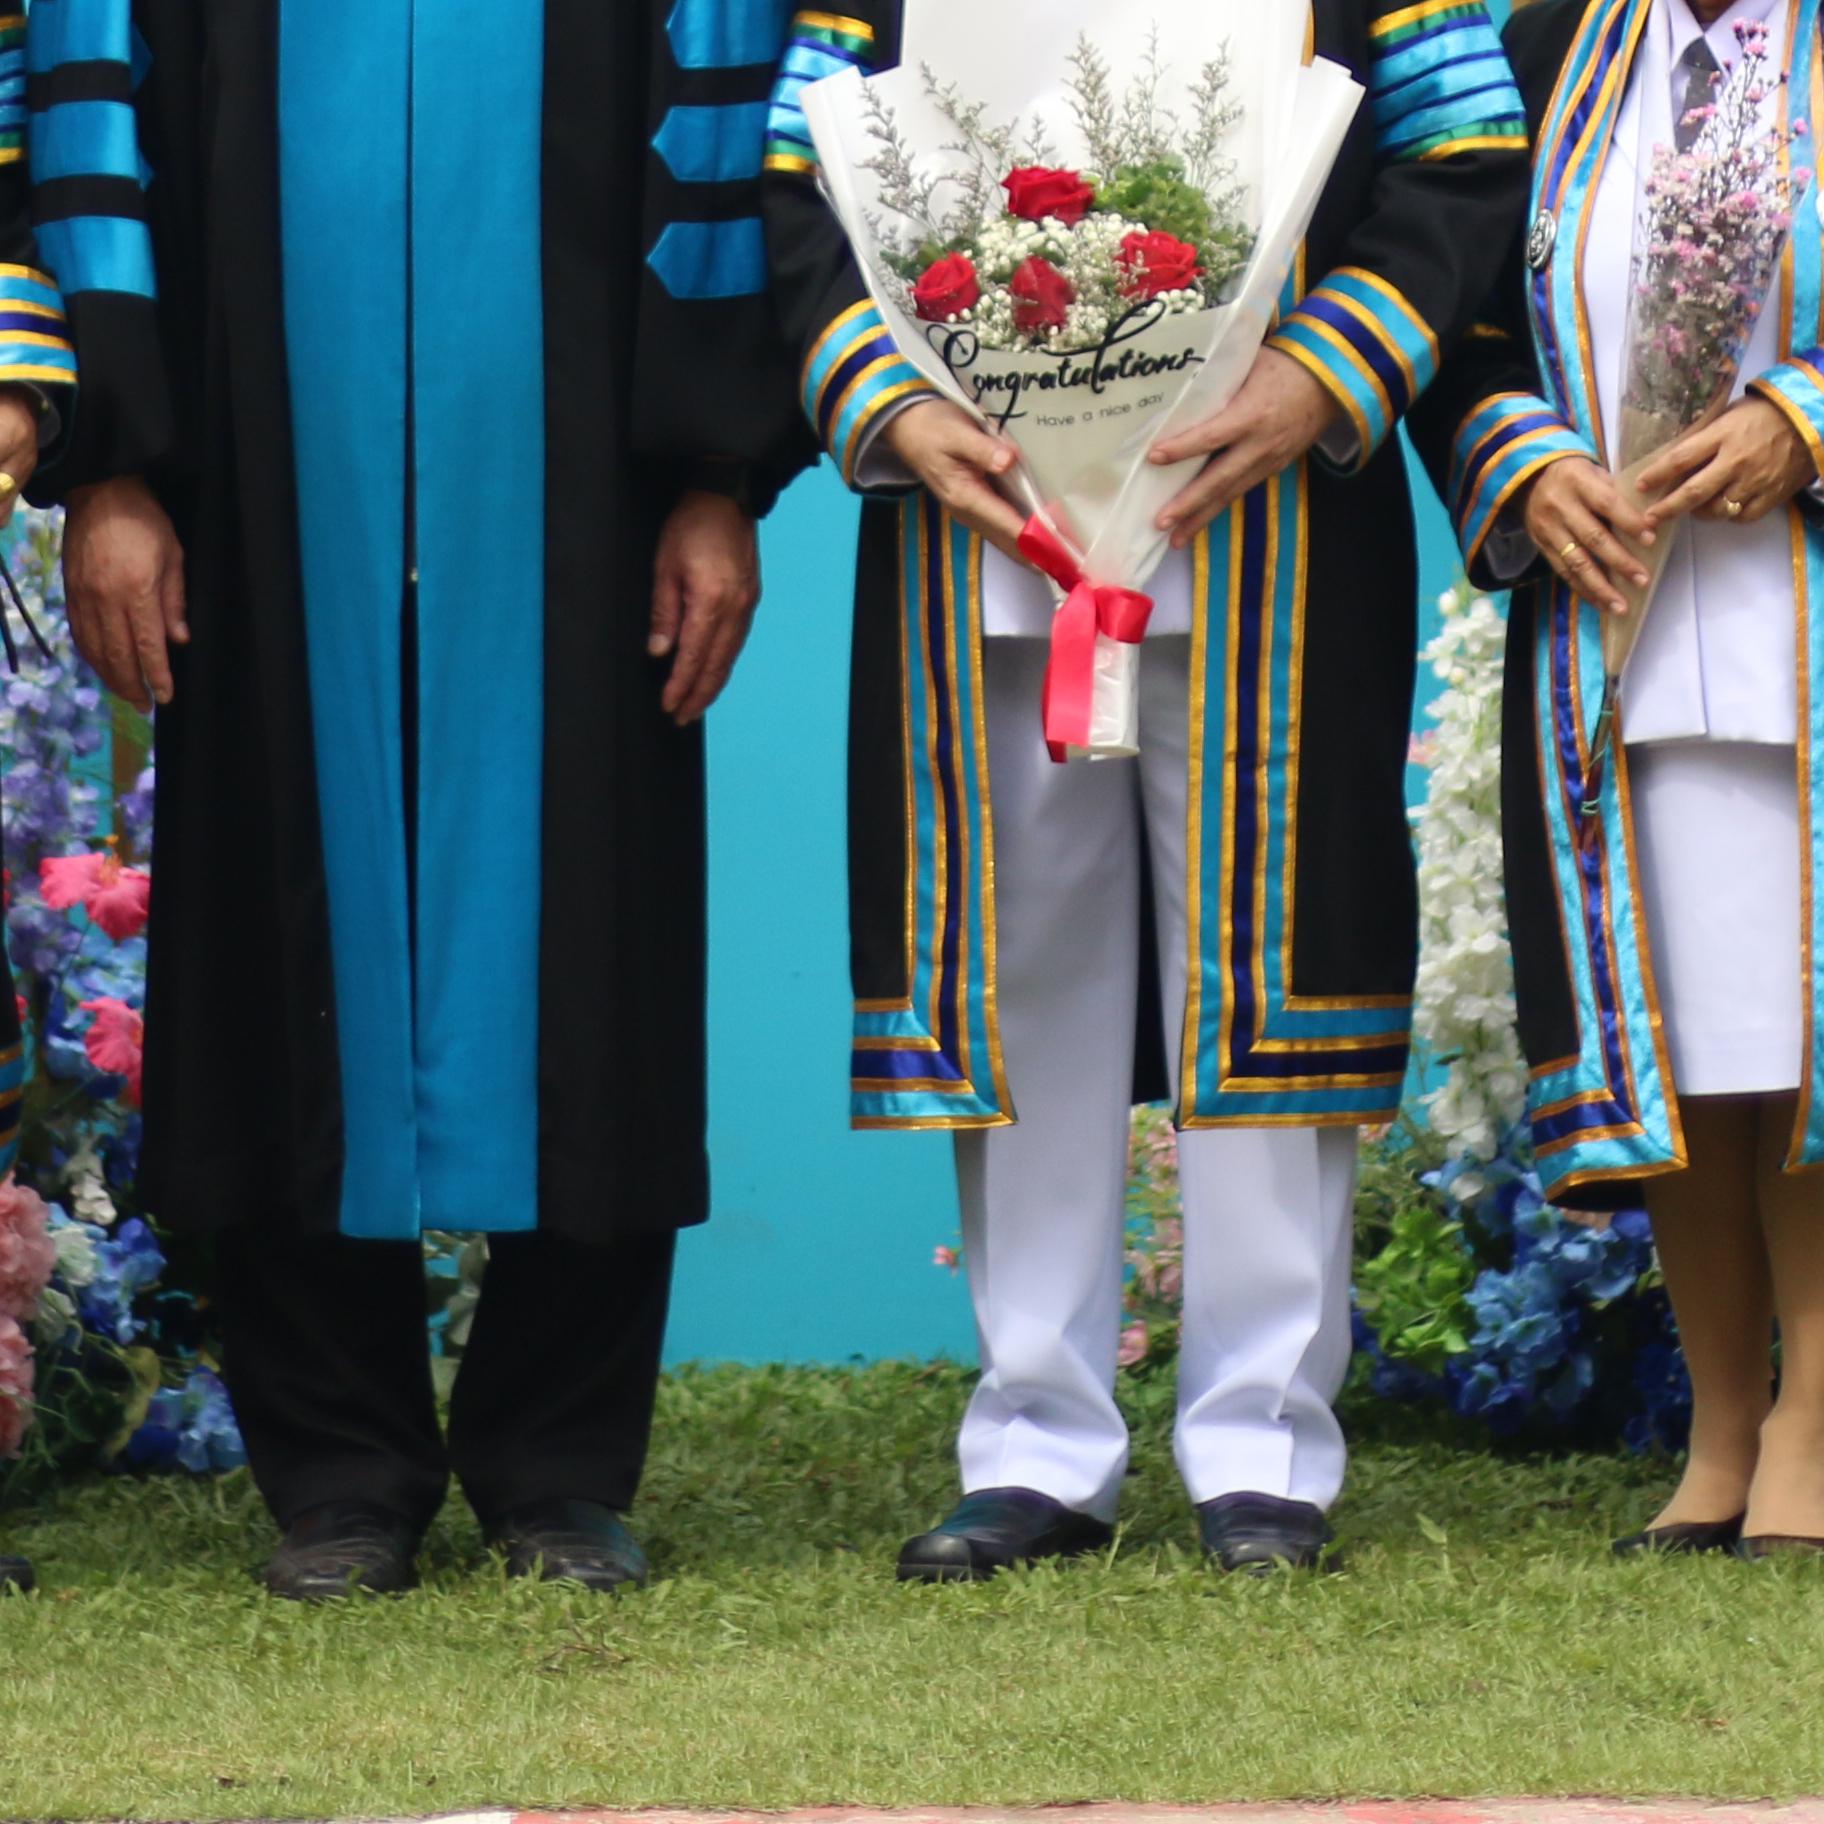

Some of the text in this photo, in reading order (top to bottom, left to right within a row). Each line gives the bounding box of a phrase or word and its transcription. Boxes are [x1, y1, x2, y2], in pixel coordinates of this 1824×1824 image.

[926, 299, 1205, 433] Congratulations
[1036, 392, 1165, 427] Have a nice day
